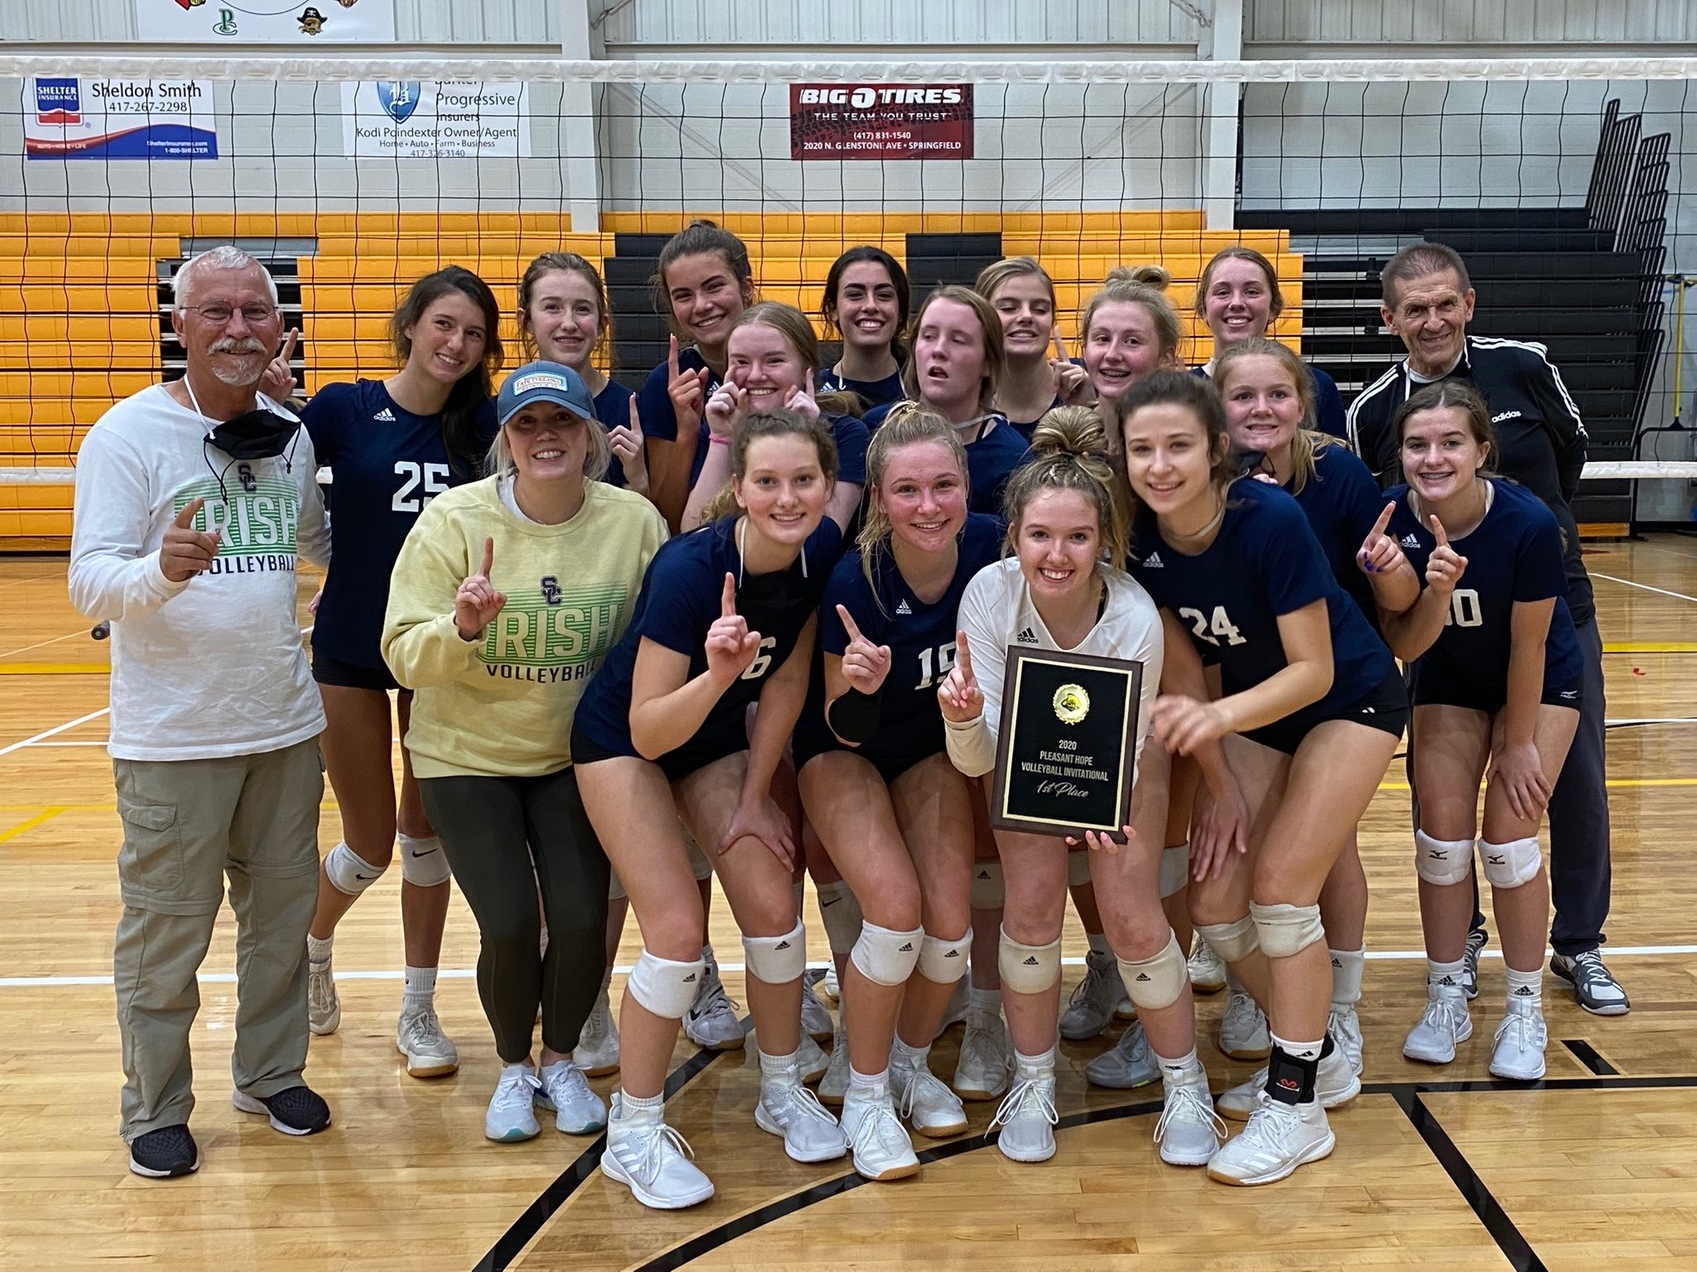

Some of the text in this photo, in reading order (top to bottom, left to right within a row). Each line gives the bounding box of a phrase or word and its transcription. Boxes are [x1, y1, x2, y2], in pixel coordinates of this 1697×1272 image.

[37, 86, 77, 95] SHELTER
[92, 82, 202, 98] Sheldon Smith
[799, 88, 849, 104] BIG
[878, 88, 961, 104] TIRES
[109, 101, 187, 112] 417-267-2298
[437, 92, 515, 109] Progressive
[814, 113, 947, 121] THE TEAM YOU TRUST
[357, 127, 517, 140] Kodi Poindexter Owner/Agent
[853, 131, 911, 140] (417) 831-1540
[380, 140, 495, 148] Home Auto Farm Business
[804, 142, 961, 150] 2020 N. GLENSTONE AVE SPRINGFIELD
[1491, 410, 1522, 423] adidas
[392, 461, 450, 512] 25
[186, 496, 298, 547] RISH
[1445, 589, 1483, 627] 0
[481, 604, 618, 659] RISH
[1179, 605, 1247, 647] 24
[486, 658, 596, 684] VOLLEYBALL
[1058, 739, 1077, 750] 2020
[1039, 751, 1094, 766] PLEASANT HOPE
[1021, 762, 1109, 781] VOLLEYBALL INVITATIONAL
[1037, 779, 1089, 798] 1st Place
